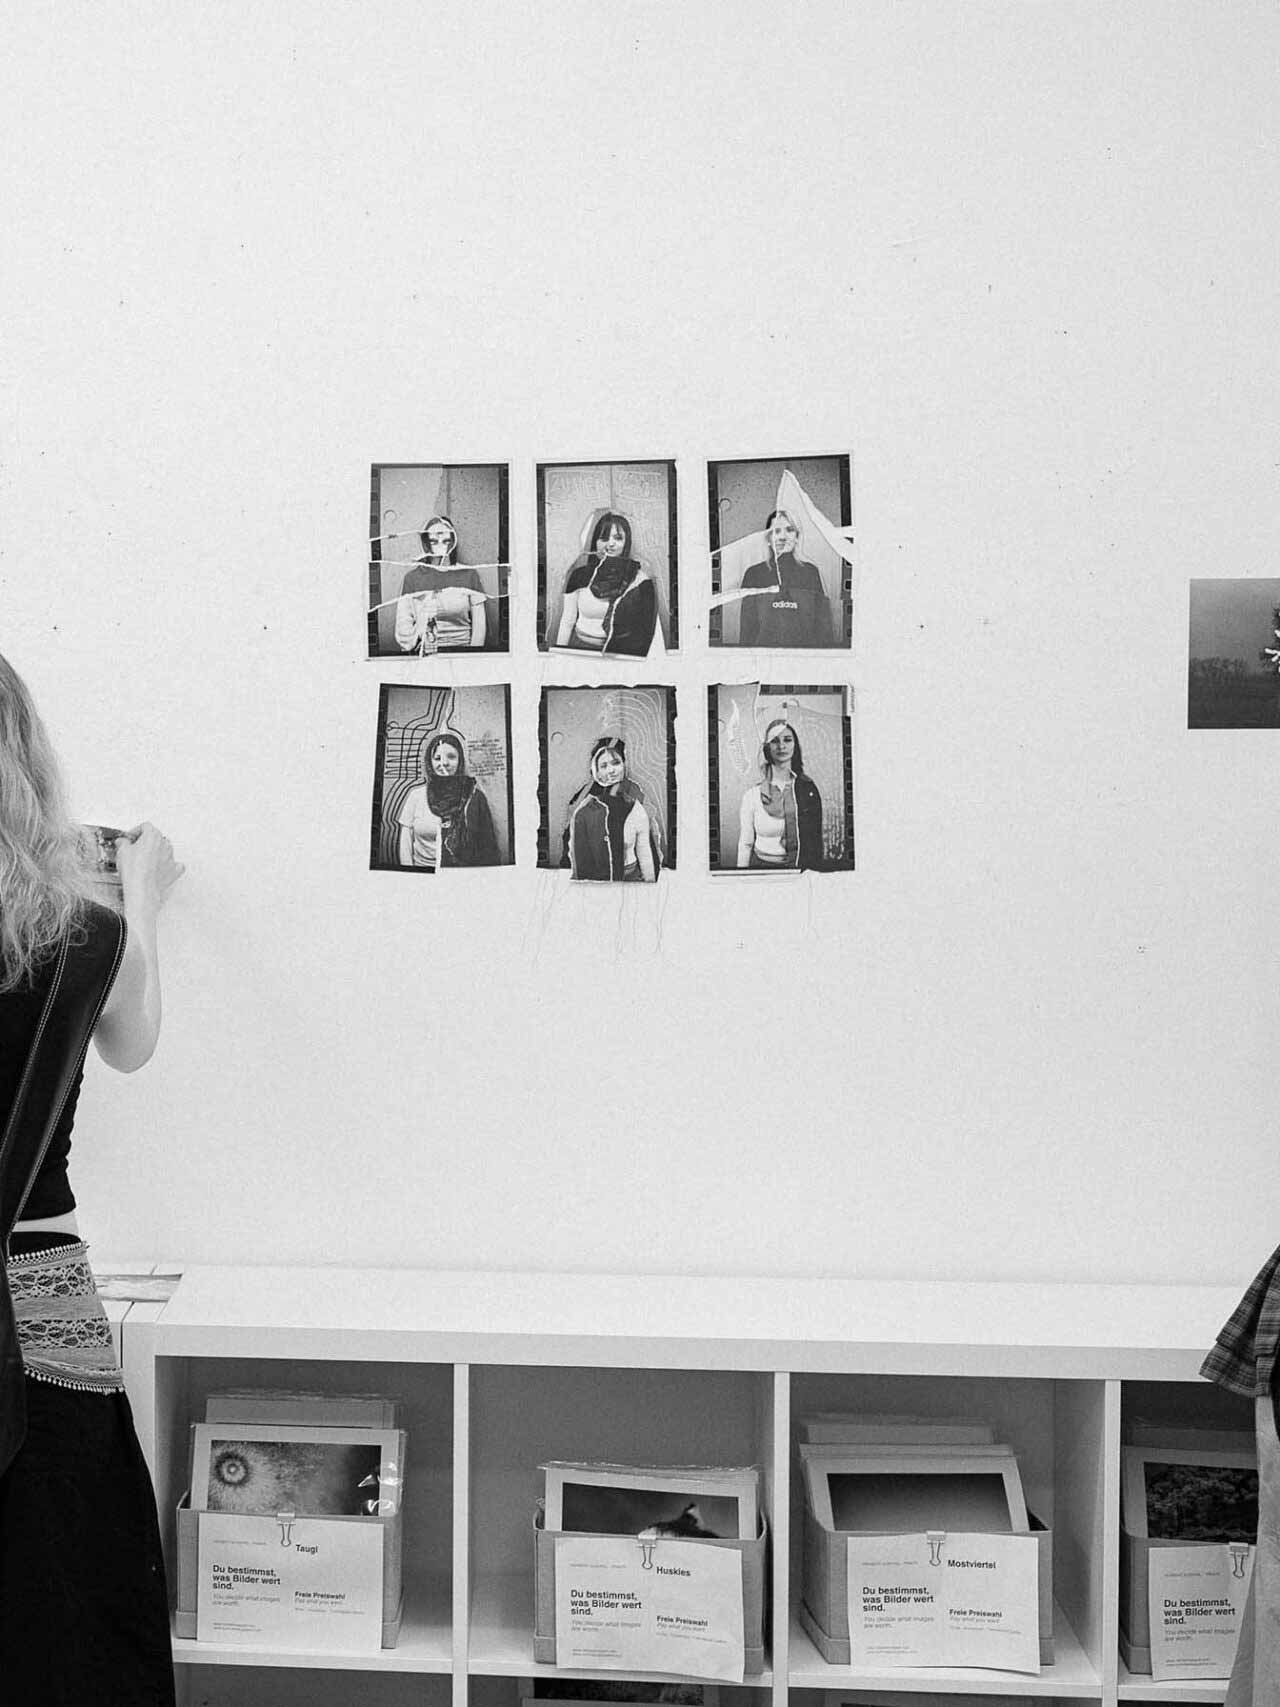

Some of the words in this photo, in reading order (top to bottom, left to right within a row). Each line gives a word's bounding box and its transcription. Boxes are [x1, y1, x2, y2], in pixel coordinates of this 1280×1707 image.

[948, 1559, 996, 1569] Mostviertel
[212, 1565, 225, 1573] Du
[227, 1566, 277, 1577] bestimmst,
[656, 1566, 691, 1577] Huskies
[232, 1574, 259, 1583] Bilder
[261, 1577, 281, 1585] wert
[570, 1589, 584, 1598] Du
[586, 1590, 638, 1601] bestimmst,
[862, 1586, 876, 1595] Du
[878, 1586, 929, 1595] bestimmst,
[591, 1600, 619, 1609] Bilder
[621, 1601, 642, 1609] wert
[862, 1596, 881, 1604] was
[883, 1595, 911, 1604] Bilder
[913, 1595, 934, 1603] wert
[1164, 1599, 1177, 1608] Du
[1179, 1598, 1231, 1608] bestimmst,
[570, 1607, 593, 1616] sind.
[862, 1603, 885, 1612] sind.
[1164, 1609, 1183, 1617] was
[1185, 1608, 1213, 1616] Bilder
[1215, 1607, 1236, 1616] wert
[1164, 1616, 1187, 1625] sind.
